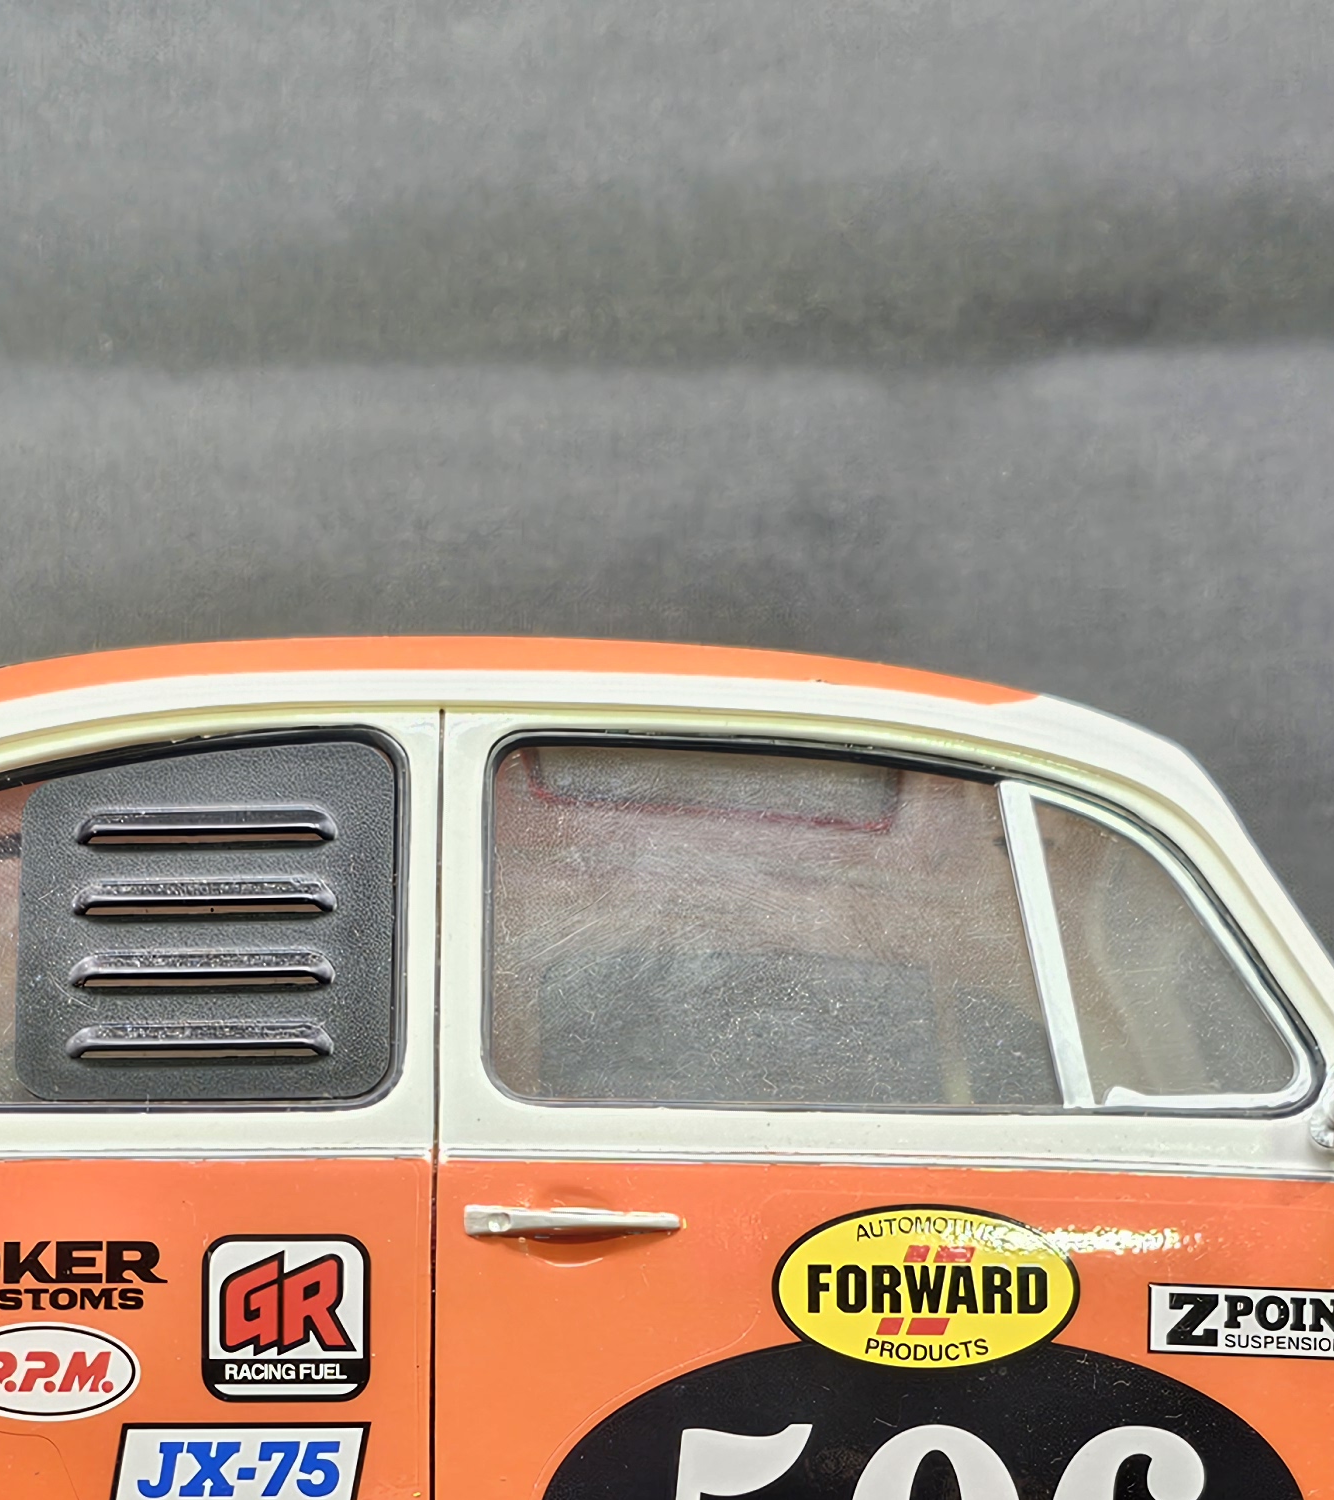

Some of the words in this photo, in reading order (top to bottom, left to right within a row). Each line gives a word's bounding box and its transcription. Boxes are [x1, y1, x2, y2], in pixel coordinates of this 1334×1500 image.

[219, 1250, 357, 1356] GR
[807, 1264, 1048, 1314] FORWARD
[224, 1363, 296, 1380] RACING
[299, 1363, 348, 1380] FUEL
[865, 1338, 989, 1361] PRODUCTS
[137, 1441, 341, 1498] JX-75
